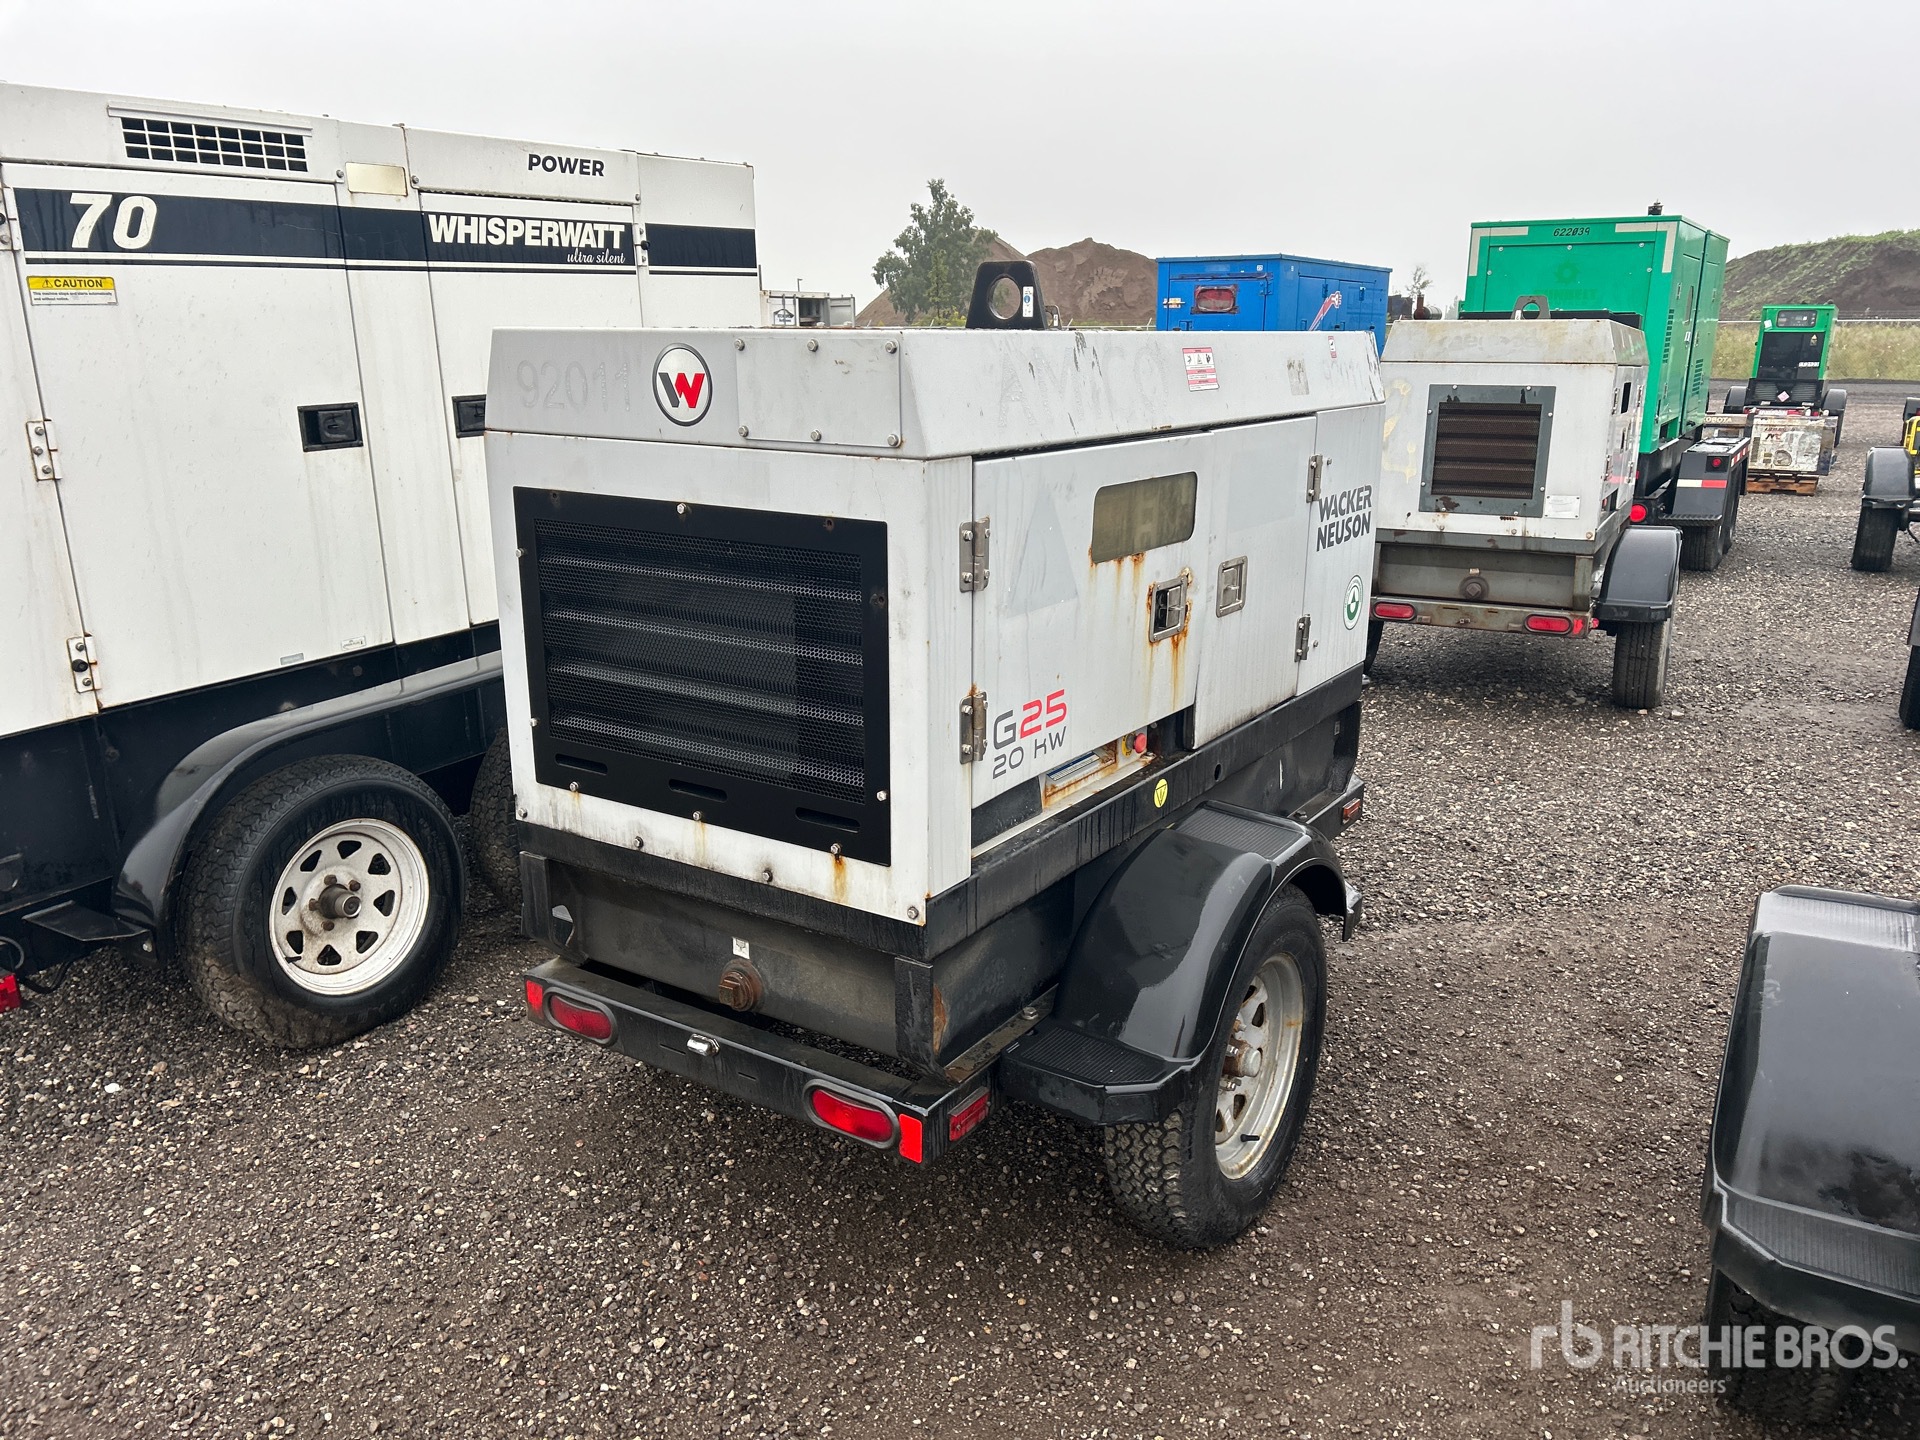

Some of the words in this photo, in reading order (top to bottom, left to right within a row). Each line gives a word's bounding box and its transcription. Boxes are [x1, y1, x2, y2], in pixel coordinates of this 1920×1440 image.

[528, 154, 604, 177] POWER
[70, 192, 157, 249] 70
[428, 214, 625, 249] WHISPERWATT
[1553, 227, 1590, 237] 622039
[567, 247, 595, 263] ultra
[595, 249, 625, 264] silent
[54, 279, 103, 288] CAUTION
[516, 360, 631, 413] 92011
[1318, 485, 1373, 522] WACKER
[1316, 511, 1371, 552] NEUSON
[993, 689, 1067, 750] G25
[992, 746, 1024, 779] 20
